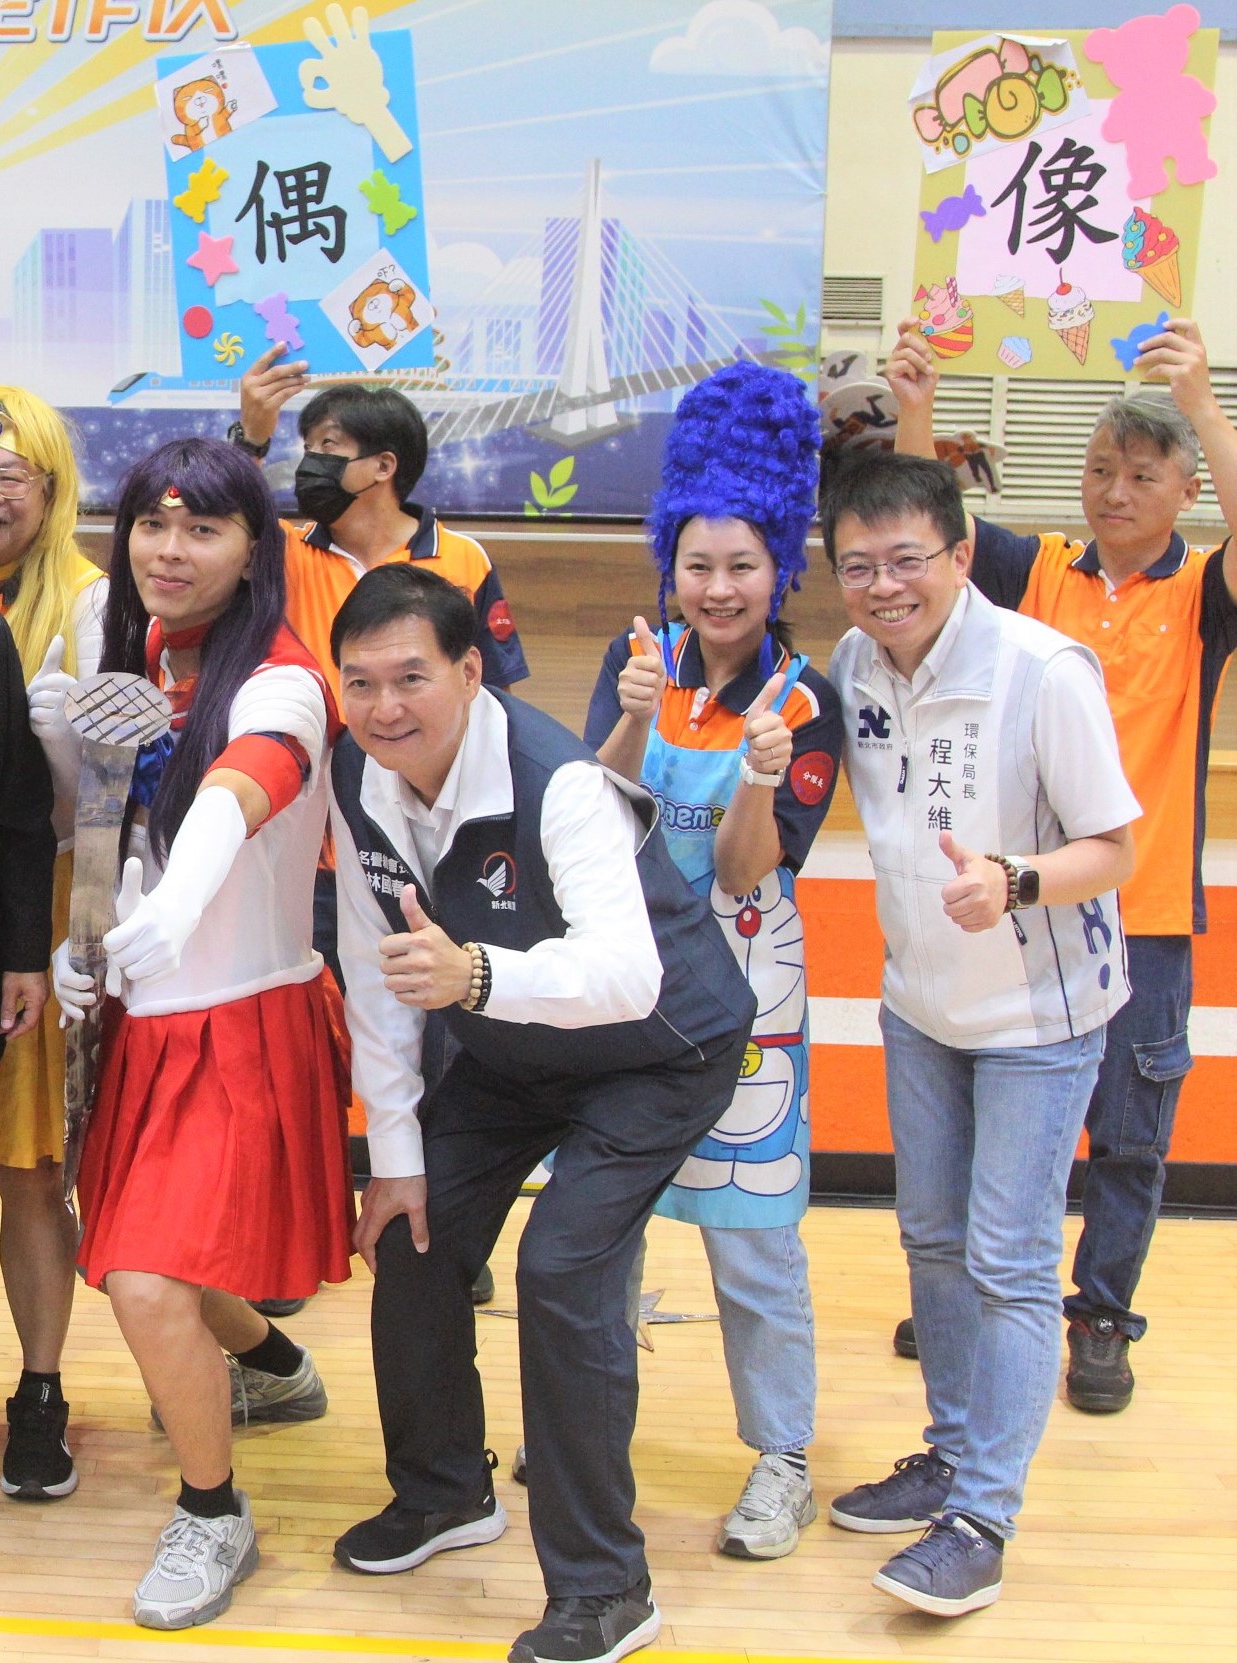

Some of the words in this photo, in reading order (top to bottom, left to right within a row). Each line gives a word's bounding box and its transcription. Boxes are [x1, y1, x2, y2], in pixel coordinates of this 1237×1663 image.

[234, 160, 348, 265] 偶
[990, 137, 1120, 265] 像
[857, 741, 894, 751] 新北市政府
[927, 737, 954, 831] 程大維
[961, 722, 979, 800] 環保局長
